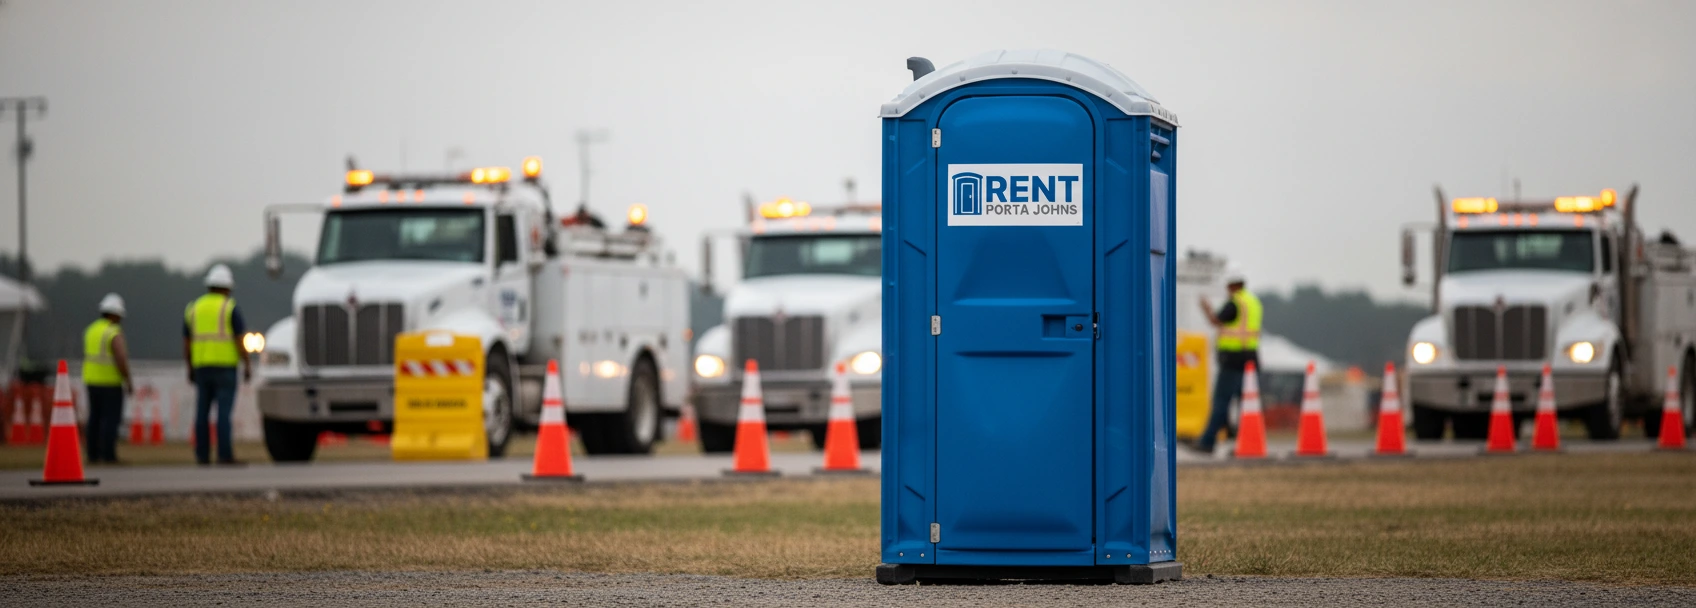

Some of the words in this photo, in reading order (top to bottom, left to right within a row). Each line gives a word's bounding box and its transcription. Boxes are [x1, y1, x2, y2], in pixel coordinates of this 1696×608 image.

[985, 175, 1080, 203] RENT
[985, 204, 1029, 215] PORTA
[1033, 204, 1078, 215] JOHNS
